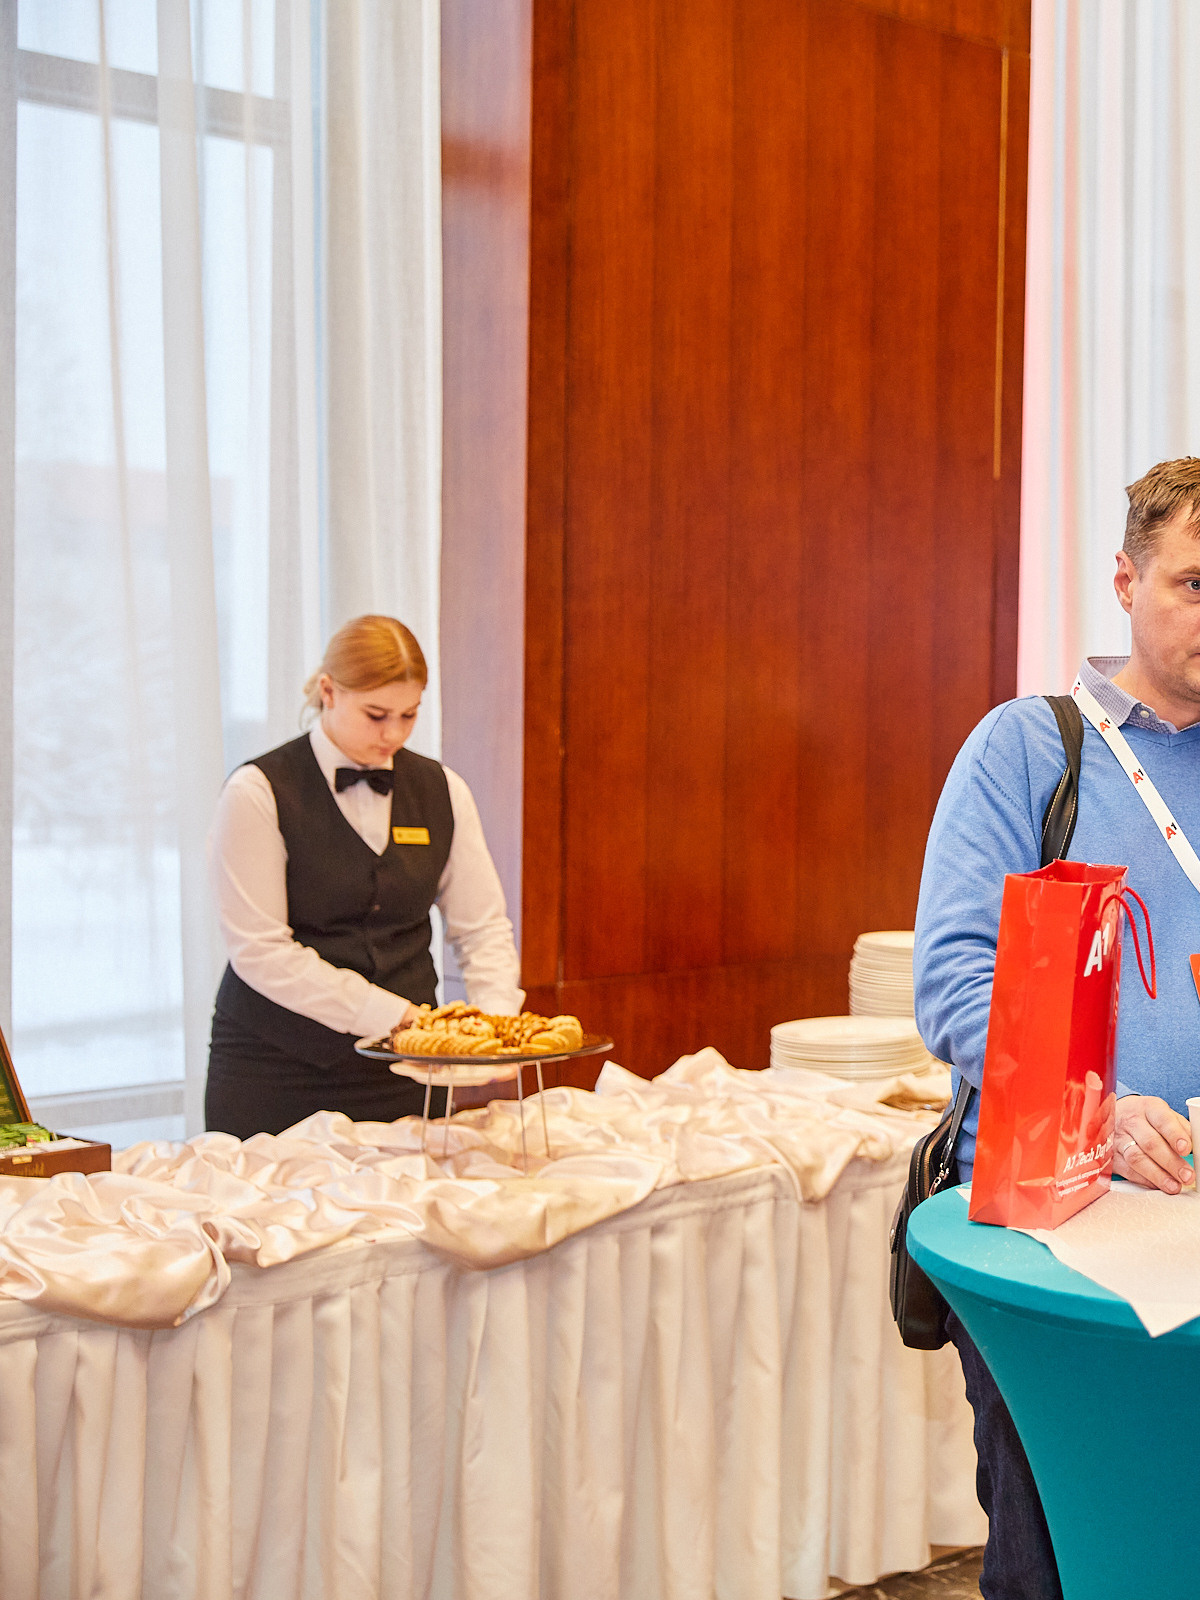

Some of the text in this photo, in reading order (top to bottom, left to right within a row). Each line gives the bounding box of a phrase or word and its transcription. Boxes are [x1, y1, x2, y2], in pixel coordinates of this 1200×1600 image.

[1099, 717, 1111, 732] A1
[1132, 768, 1144, 784] A1
[1165, 822, 1178, 840] A1
[1083, 922, 1110, 977] A1
[1063, 1154, 1077, 1174] A1
[1075, 1147, 1095, 1167] Tech
